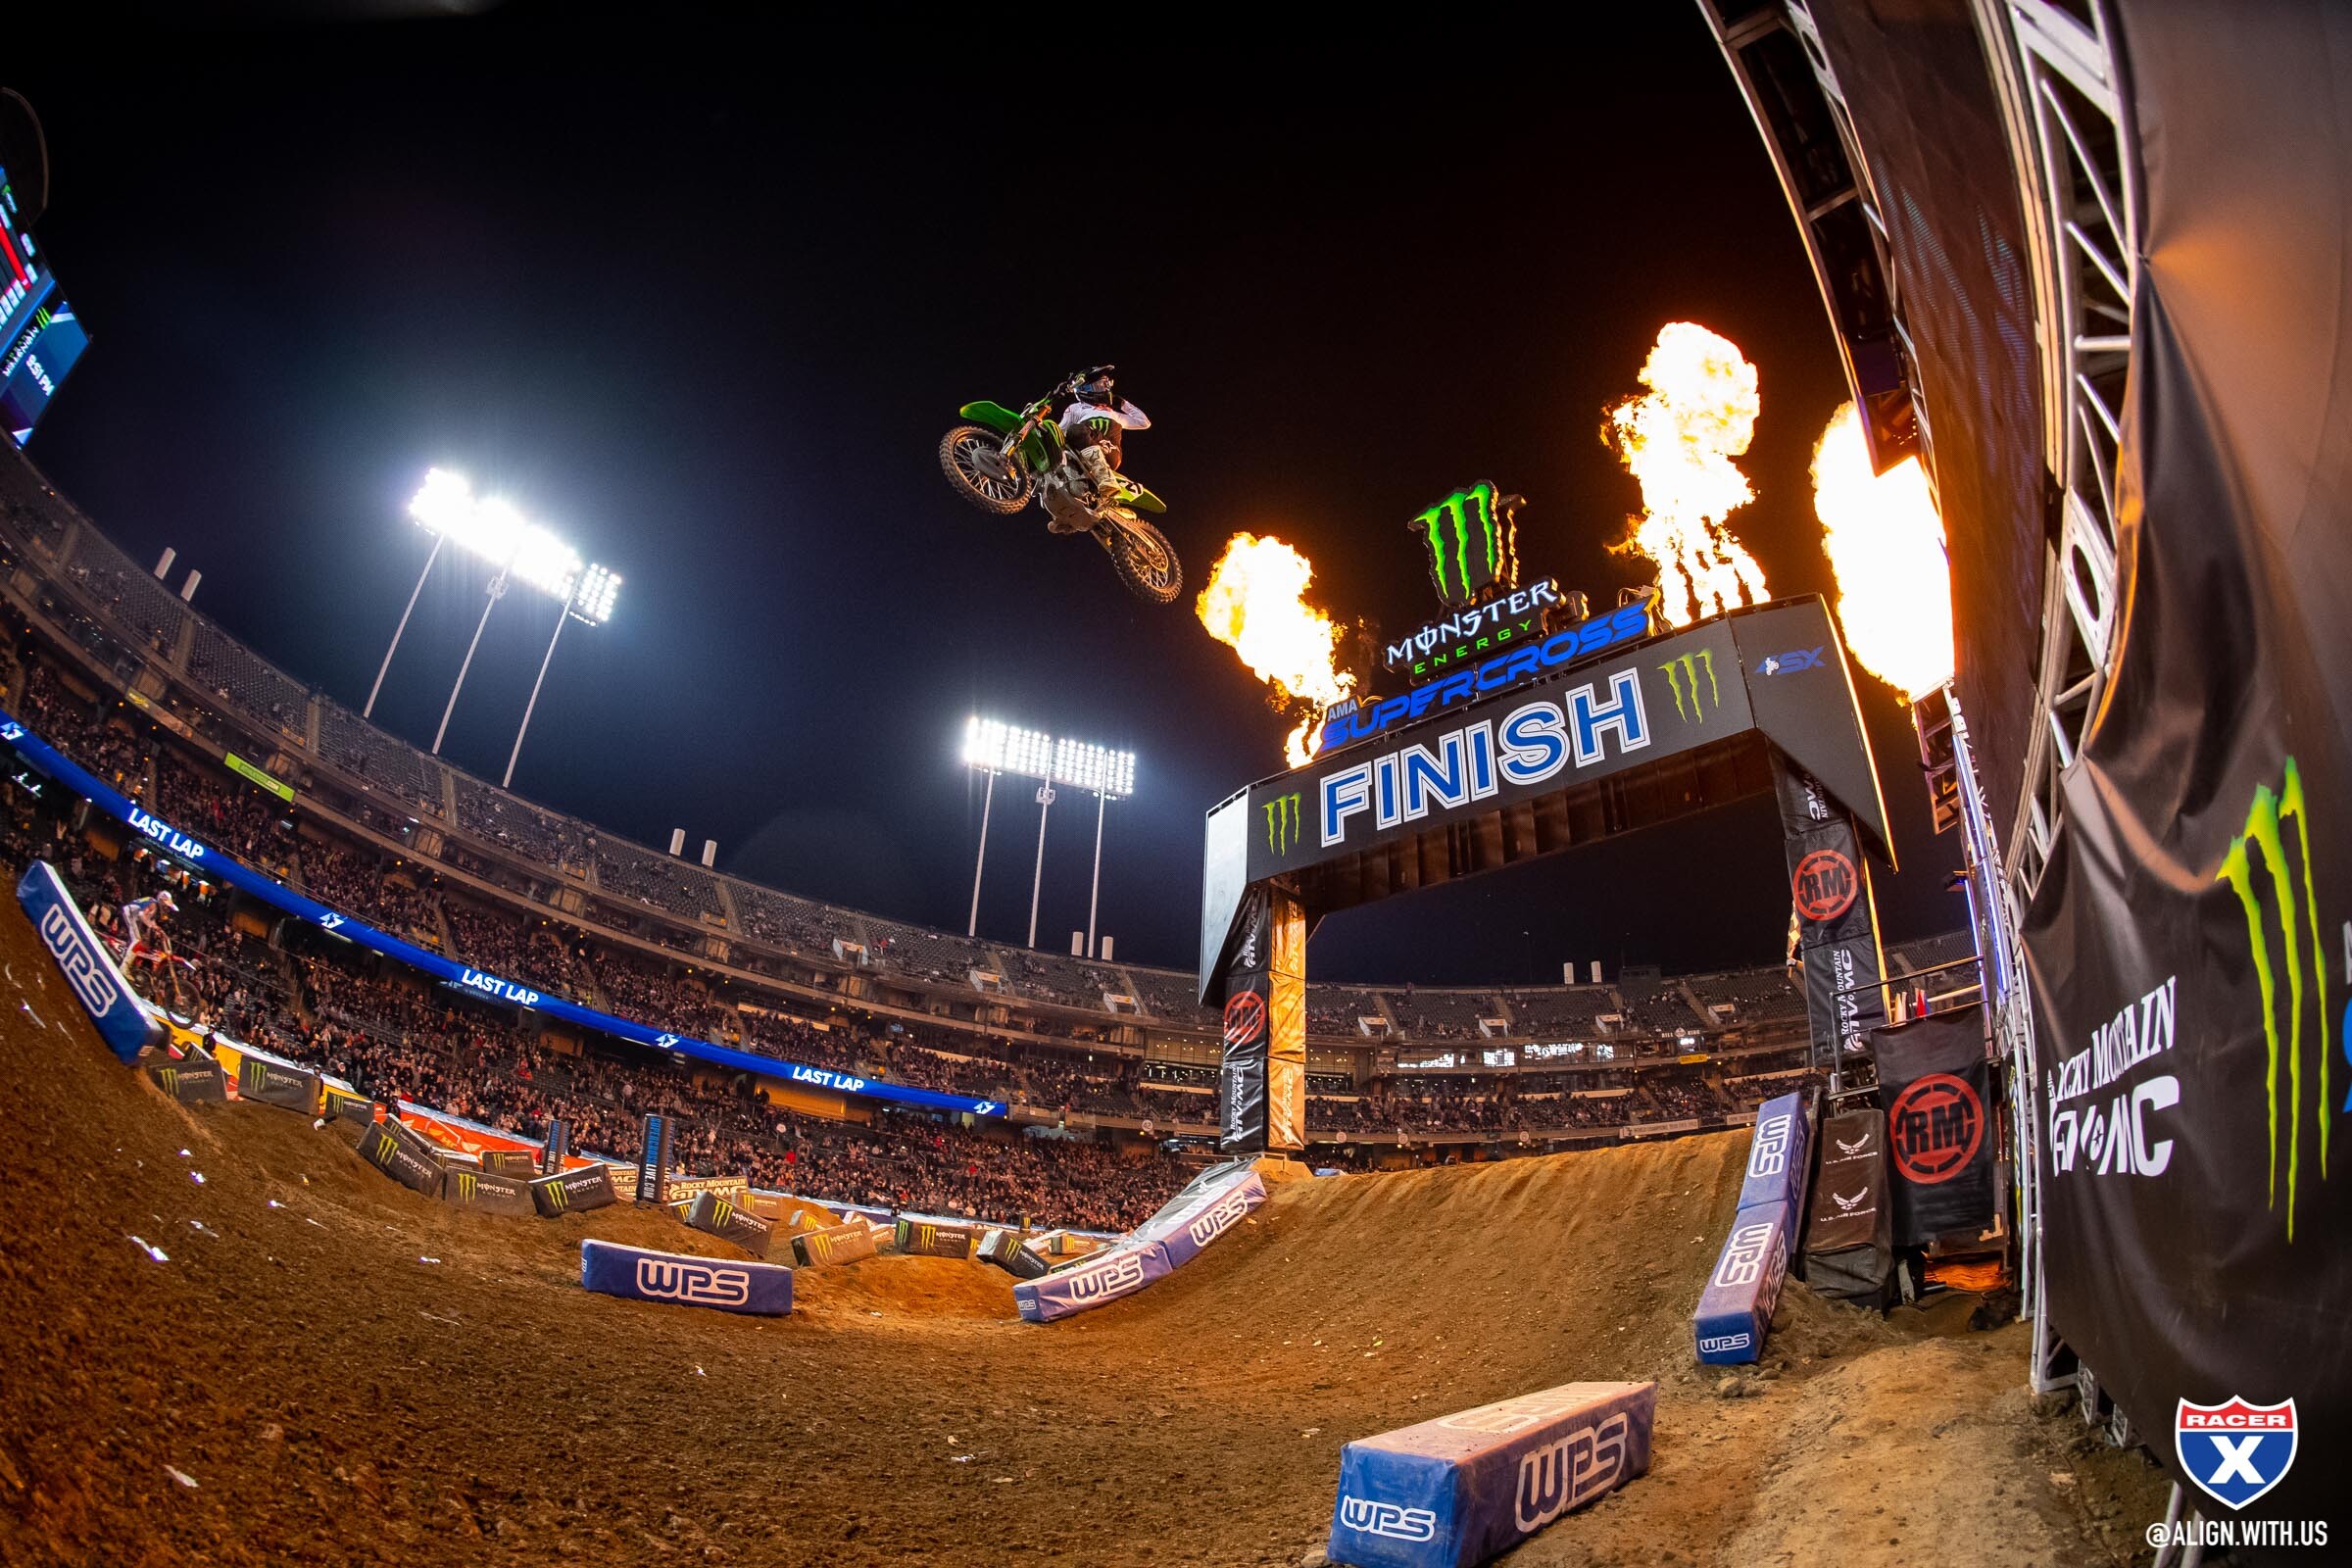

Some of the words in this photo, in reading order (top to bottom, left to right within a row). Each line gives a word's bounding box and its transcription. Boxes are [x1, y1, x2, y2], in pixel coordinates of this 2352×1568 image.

[1387, 578, 1558, 665] MONSTER
[1414, 619, 1532, 675] ENERGY
[1320, 602, 1649, 753] SUPERCROSS
[1327, 699, 1358, 722] AMA
[1320, 667, 1651, 848] FINISH
[127, 808, 172, 842] LAST
[169, 832, 204, 858] LAP
[41, 904, 117, 1017] WPS
[461, 969, 505, 994] LAST
[505, 985, 539, 1004] LAP
[1839, 1004, 1850, 1035] ROCKY
[177, 1070, 214, 1080] MONSTER
[266, 1071, 304, 1088] MONSTER
[792, 1066, 833, 1086] LAST
[833, 1075, 864, 1092] LAP
[1748, 1114, 1790, 1178] WPS
[396, 1150, 432, 1178] MONSTER
[476, 1183, 516, 1196] MONSTER
[564, 1176, 603, 1191] MONSTER
[707, 1179, 746, 1188] MOUNTAIN
[731, 1211, 767, 1232] MONSTER
[1189, 1190, 1248, 1247] WPS
[830, 1231, 863, 1243] MONSTER
[935, 1231, 966, 1240] MONSTER
[1019, 1250, 1045, 1270] MONSTER
[1714, 1222, 1774, 1288] WPS
[637, 1258, 750, 1306] WPS
[1069, 1254, 1145, 1303] WPS
[1699, 1333, 1750, 1353] WPS
[1514, 1411, 1629, 1534] WPS
[1341, 1494, 1437, 1543] WPS
